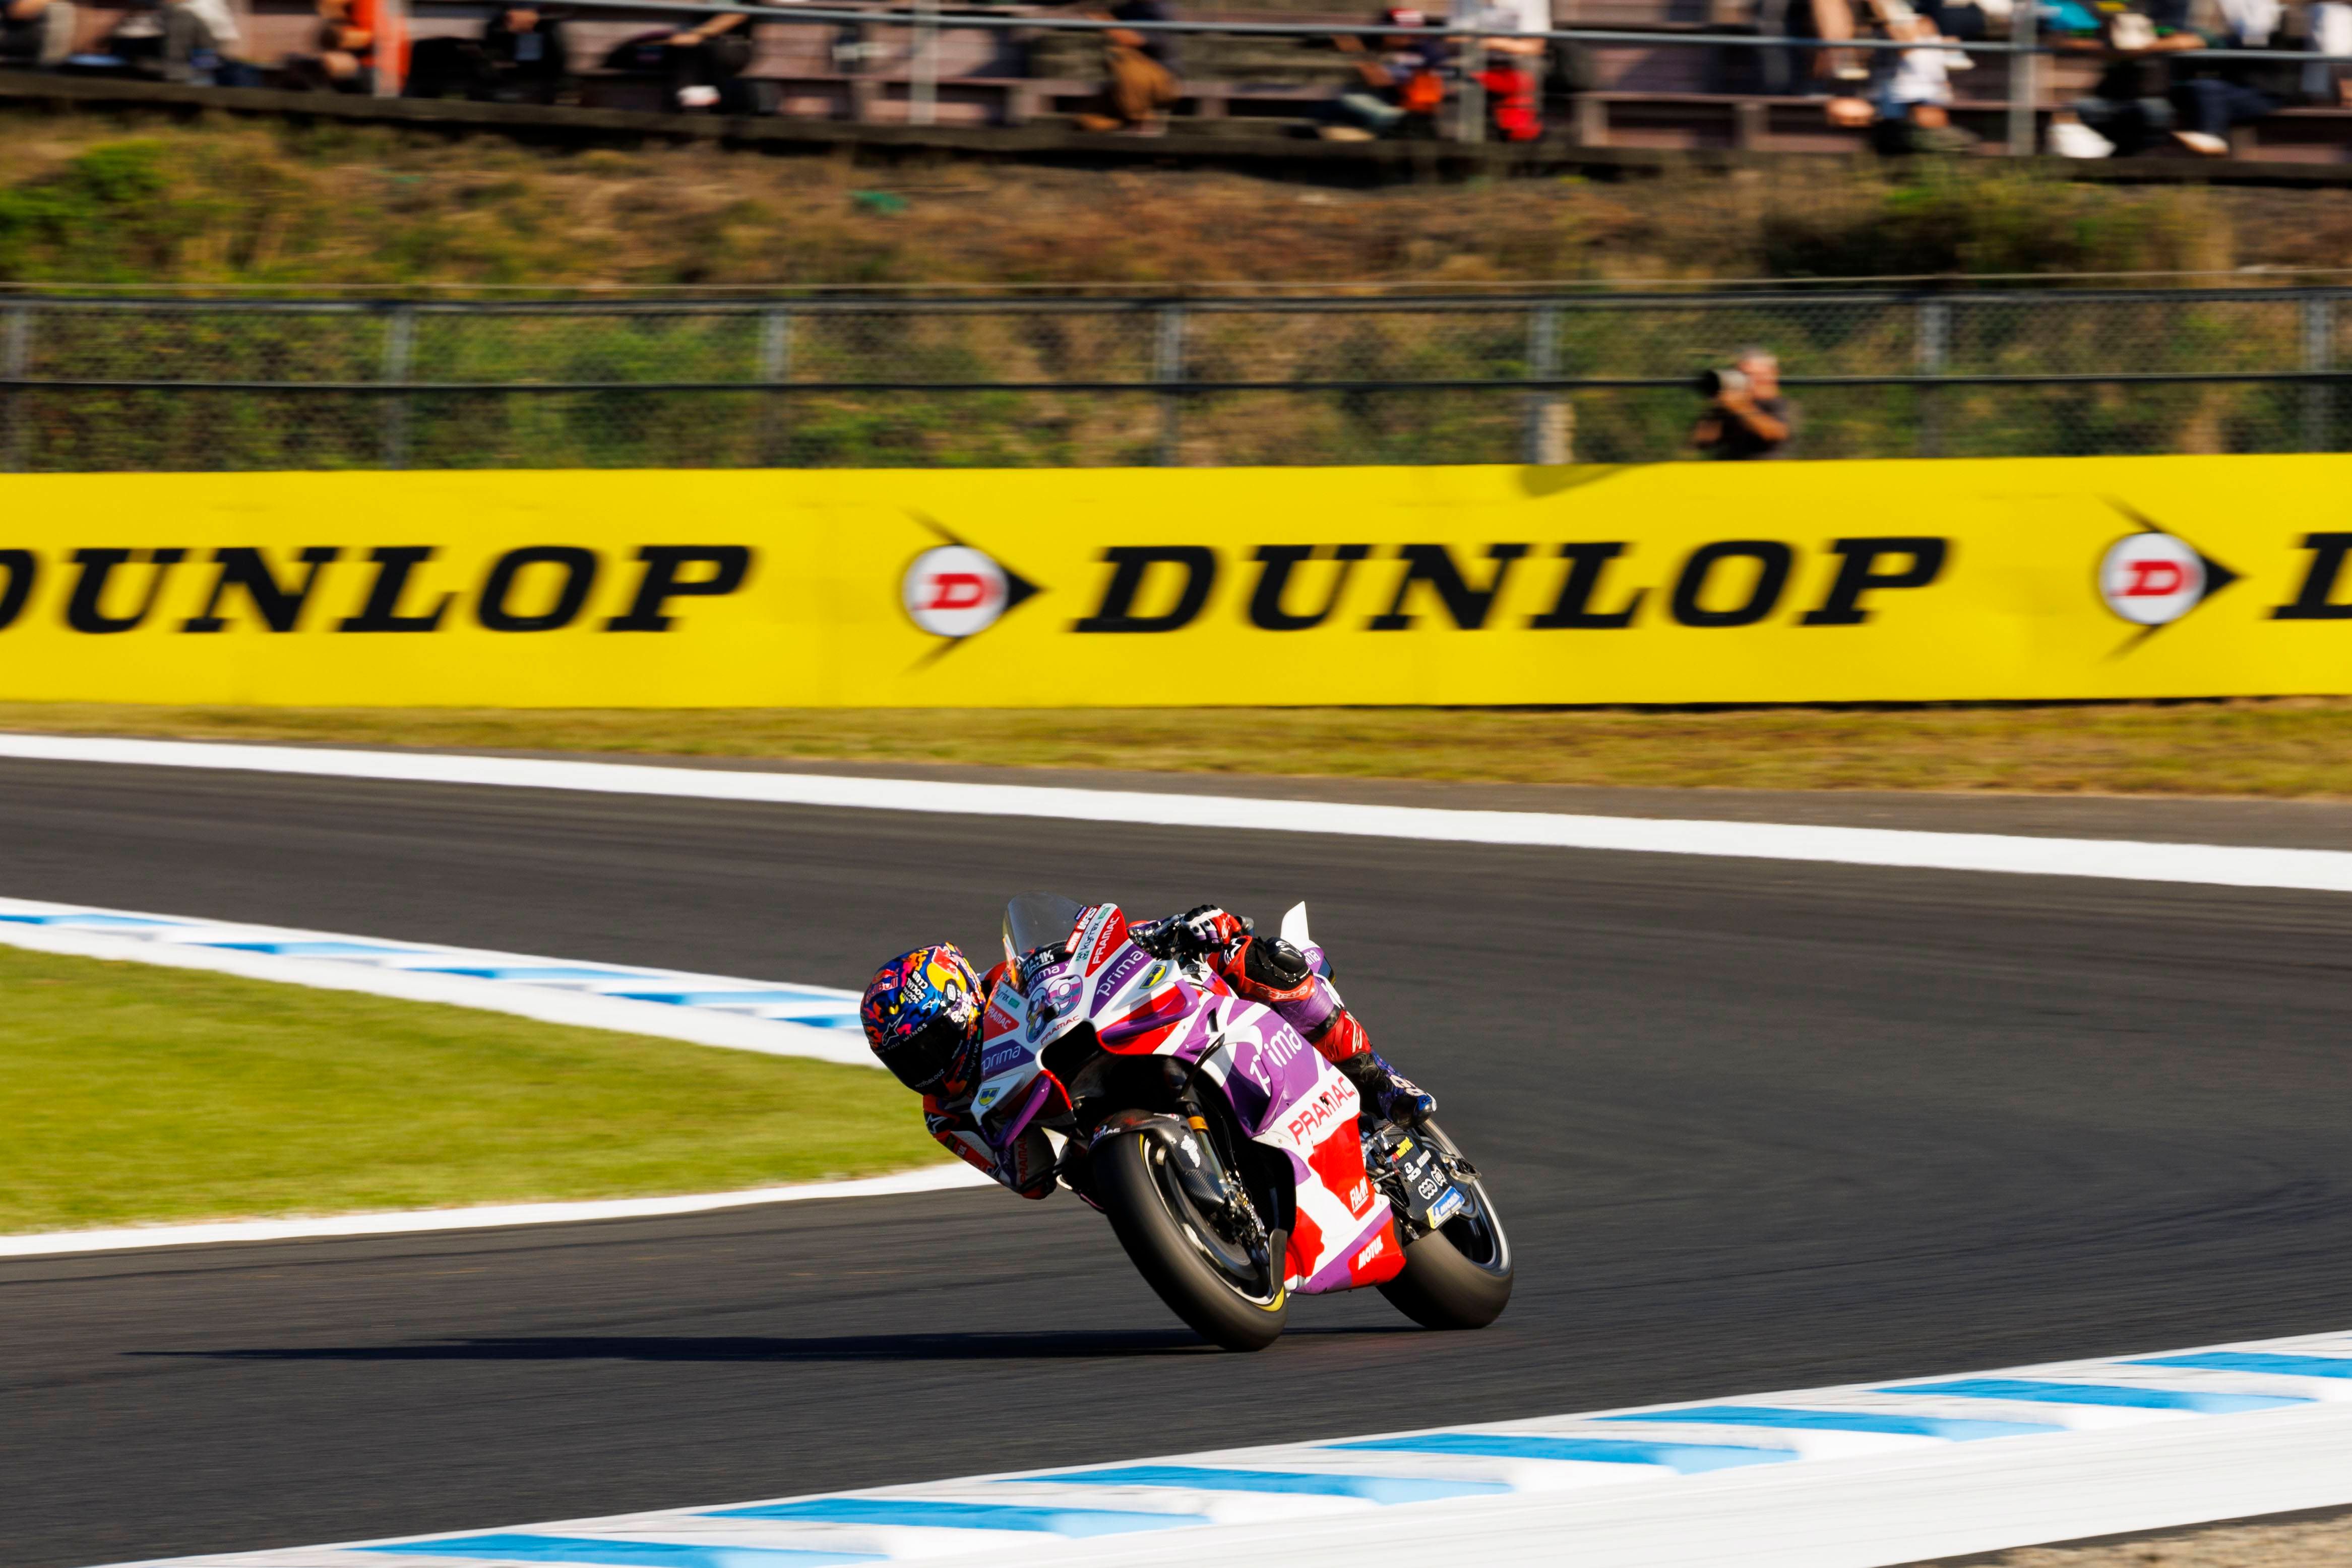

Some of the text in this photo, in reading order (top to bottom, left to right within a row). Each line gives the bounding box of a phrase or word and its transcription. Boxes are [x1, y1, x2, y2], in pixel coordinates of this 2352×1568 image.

[0, 546, 756, 634] UNLOP
[921, 573, 992, 610] D
[1065, 537, 1952, 634] DUNLOP
[2113, 559, 2194, 597] D
[1092, 916, 1120, 965] PRAMAC
[1305, 950, 1320, 965] ima
[877, 977, 898, 993] Bull
[1096, 950, 1144, 996] prima
[903, 1023, 927, 1042] WINGS
[1040, 1015, 1081, 1046] PRAMAC
[981, 1045, 1021, 1076] prima
[1250, 1022, 1303, 1097] pima
[1287, 1076, 1356, 1146] PRAMAC
[1357, 1234, 1384, 1271] MOTUL
